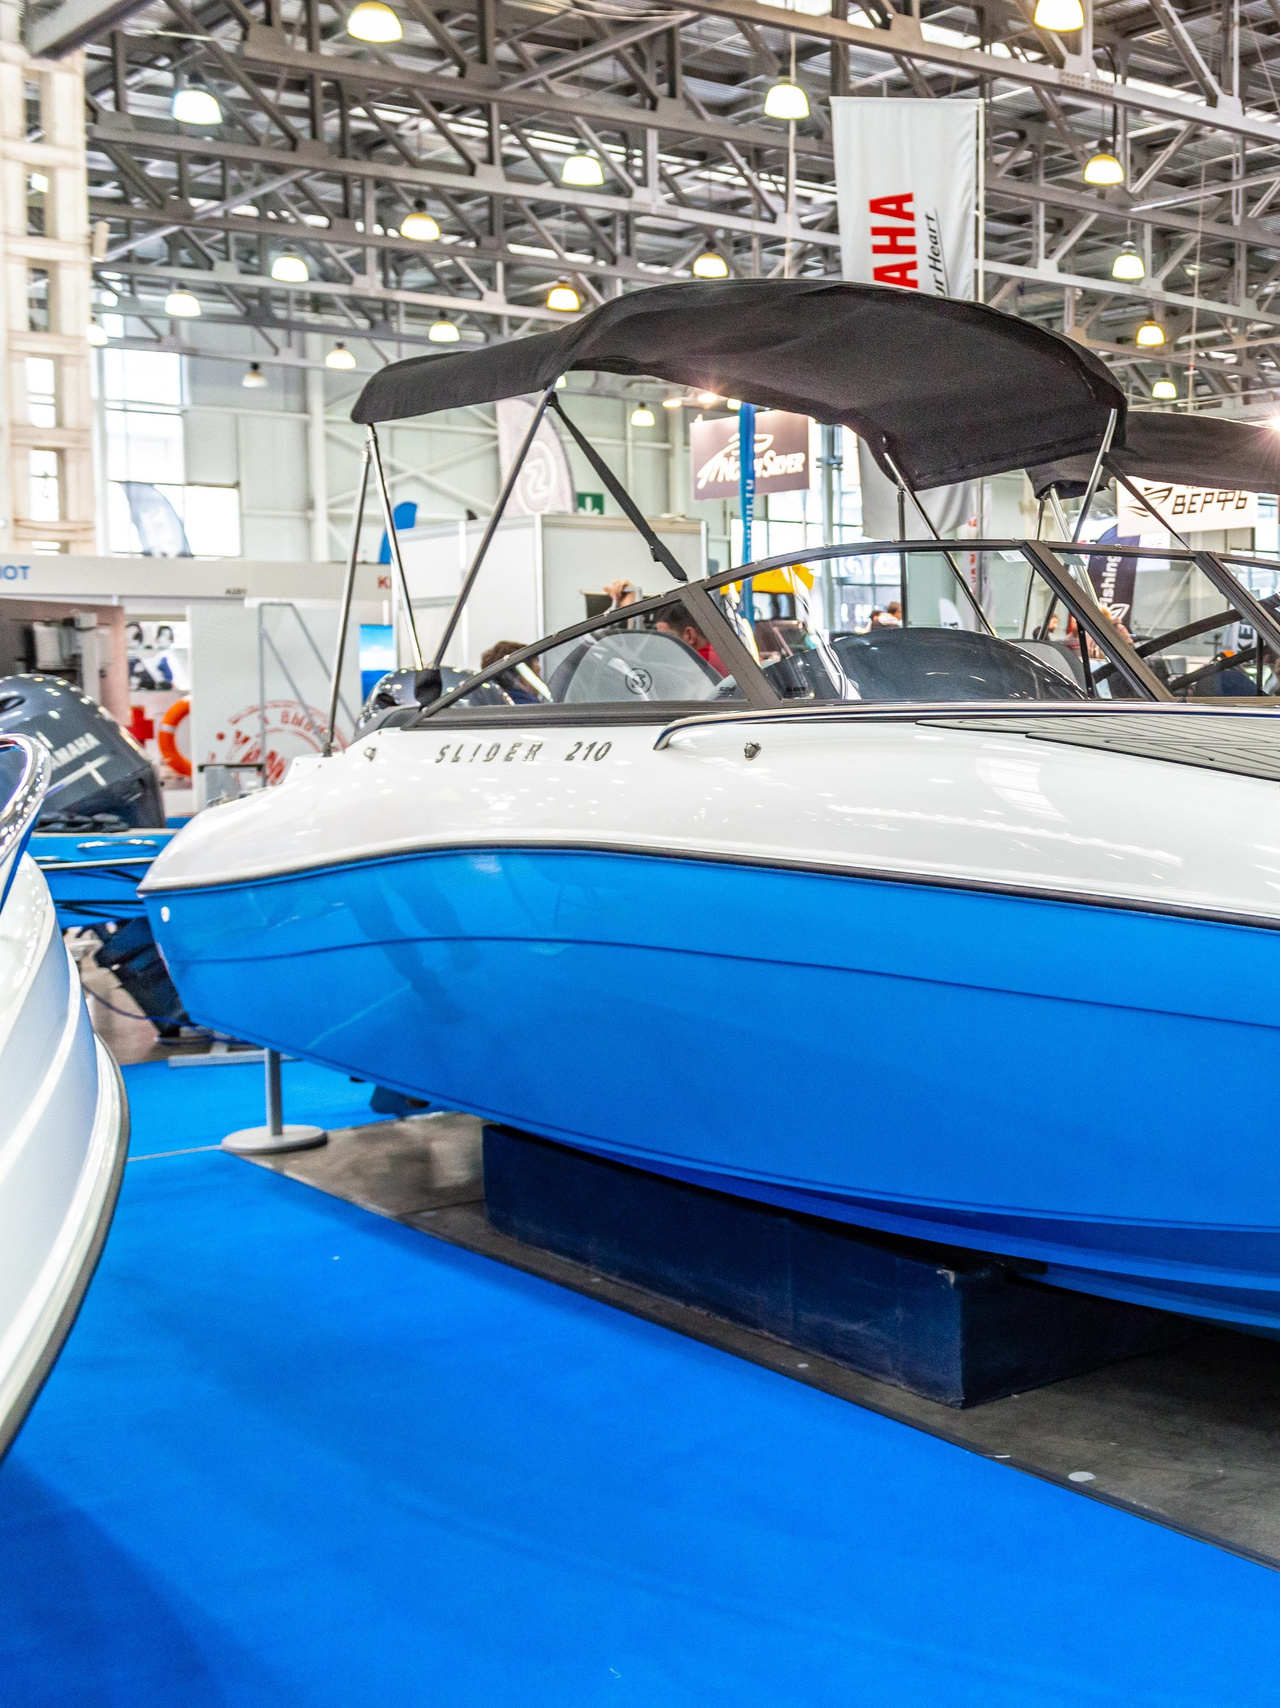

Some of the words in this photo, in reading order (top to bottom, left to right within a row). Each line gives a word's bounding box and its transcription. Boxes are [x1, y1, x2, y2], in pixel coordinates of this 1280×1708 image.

[925, 211, 943, 273] Heart
[1171, 489, 1249, 516] ВЕРФЬ
[435, 742, 544, 764] SLIDER
[564, 741, 612, 762] 210
